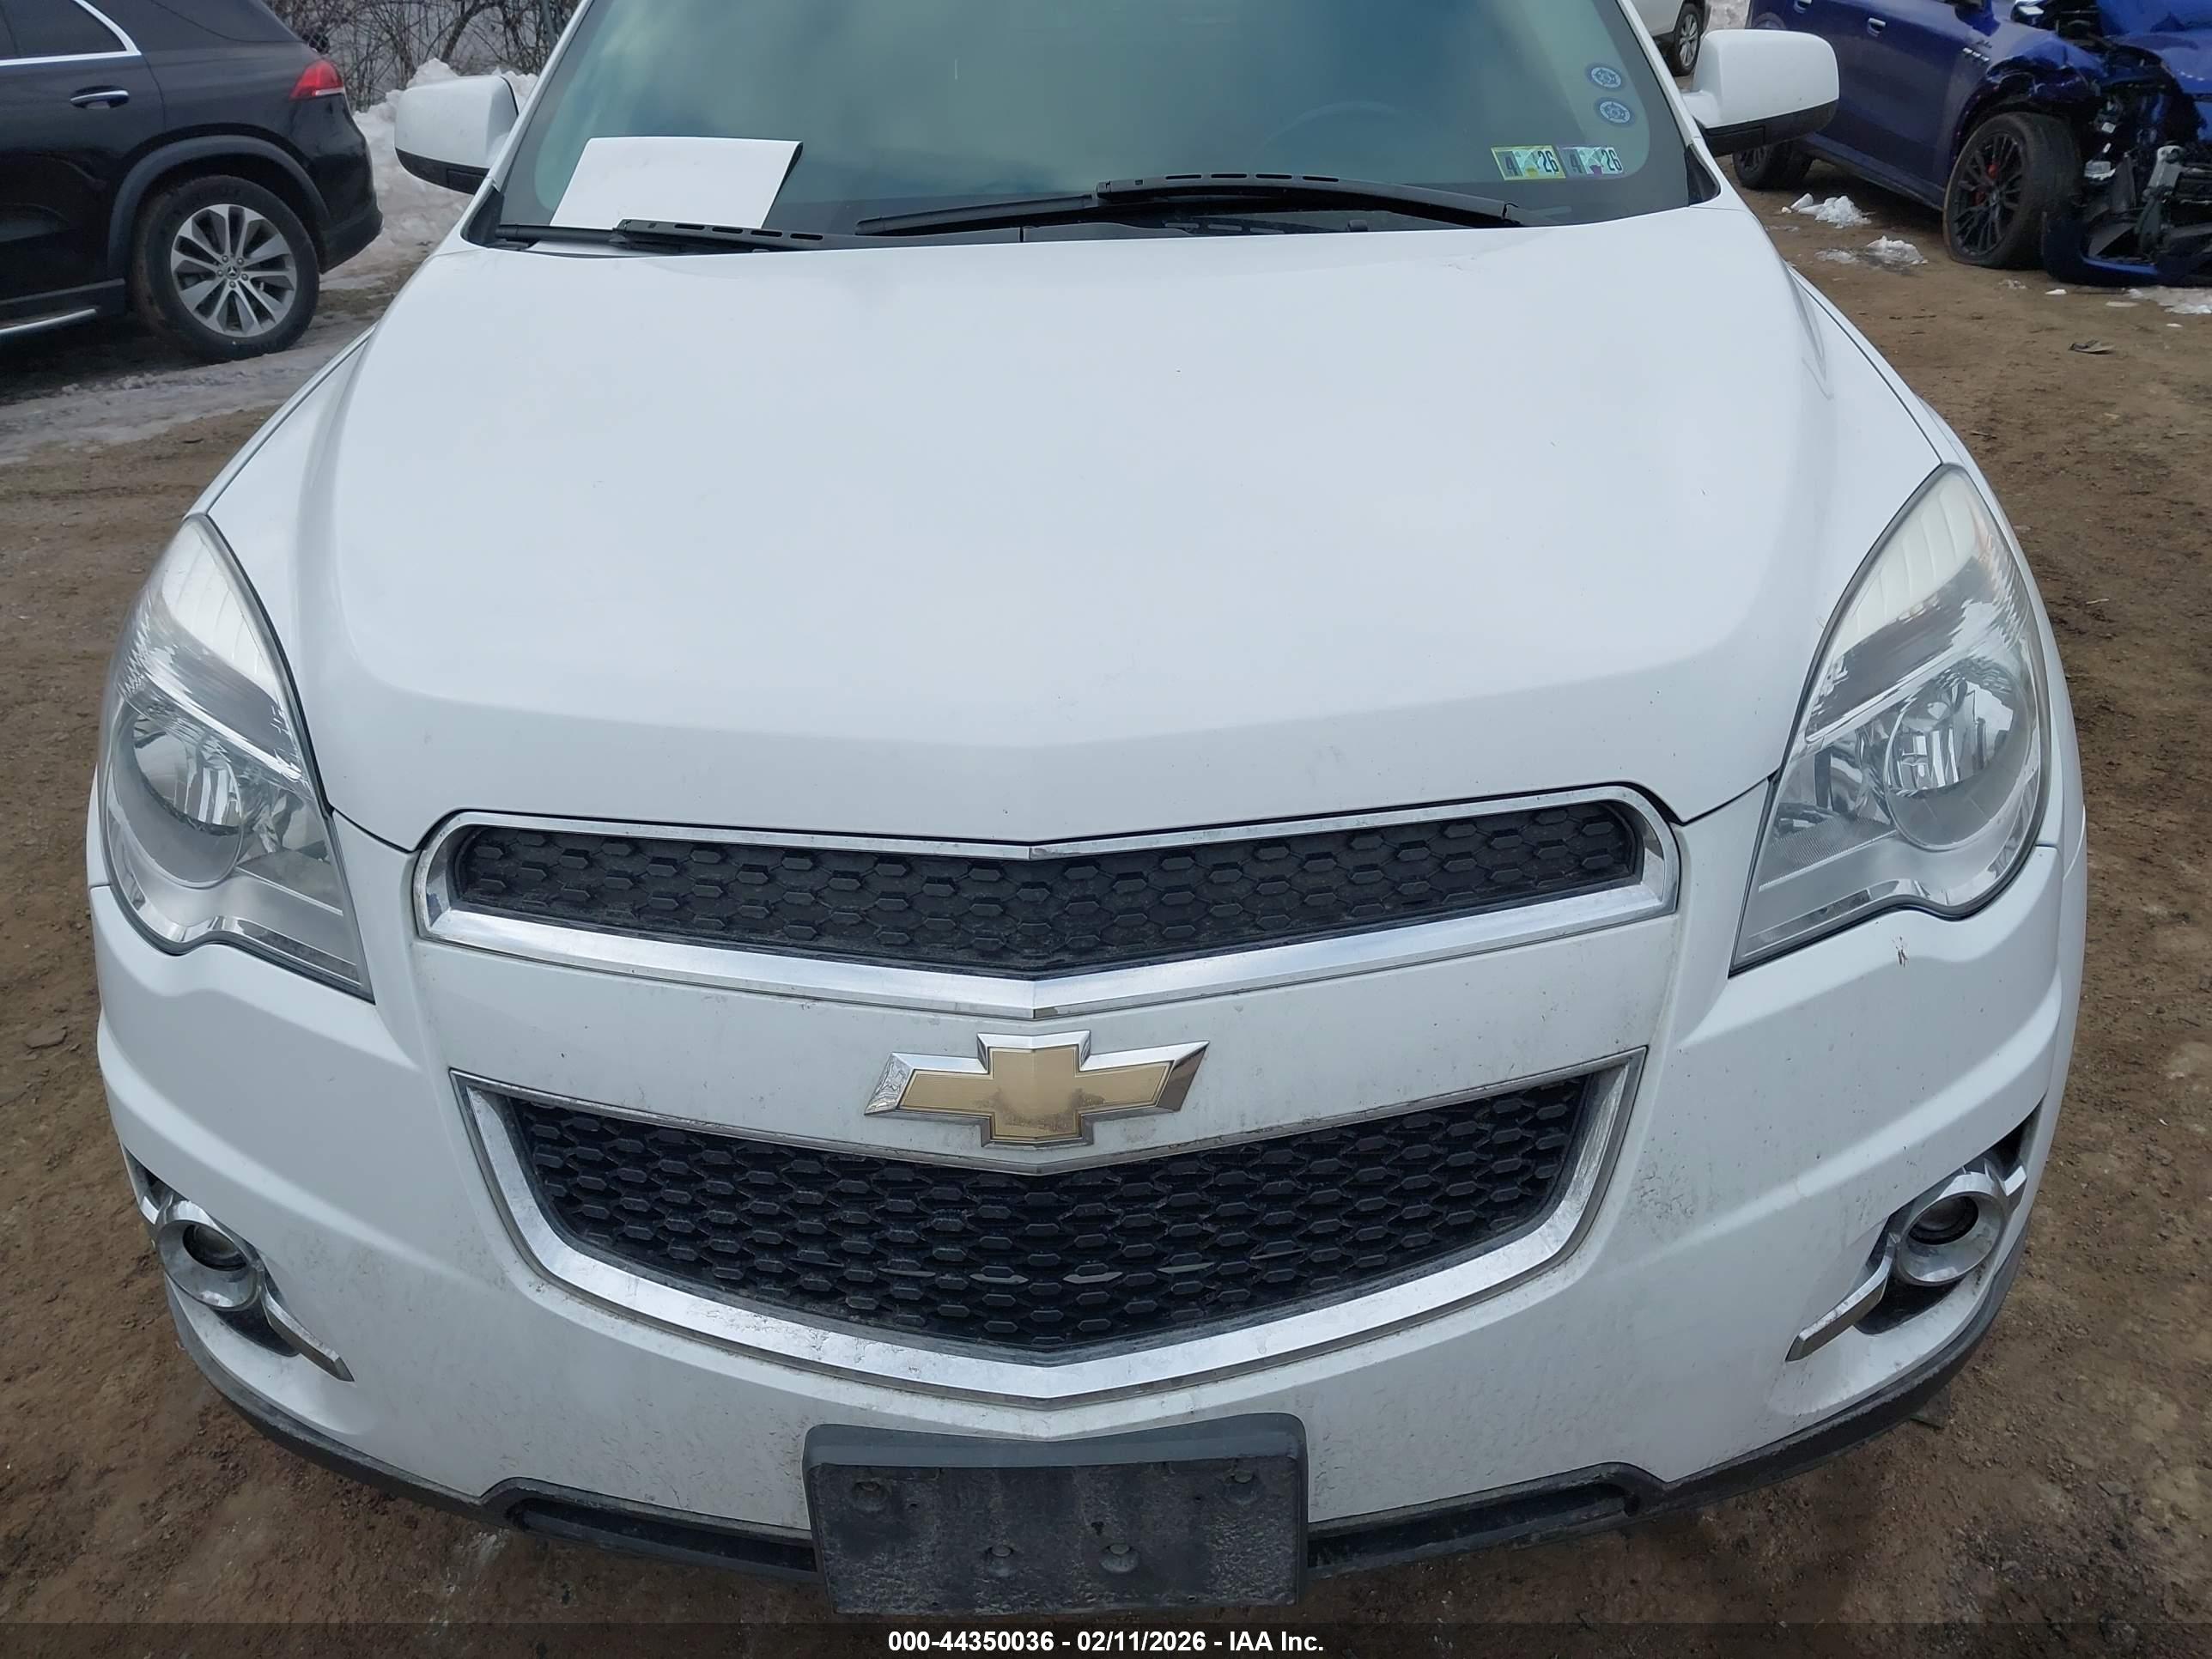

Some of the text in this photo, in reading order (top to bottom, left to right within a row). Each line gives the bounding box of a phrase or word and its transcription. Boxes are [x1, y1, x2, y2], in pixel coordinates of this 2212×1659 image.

[1504, 150, 1559, 176] 4 26
[1601, 149, 1622, 172] 26
